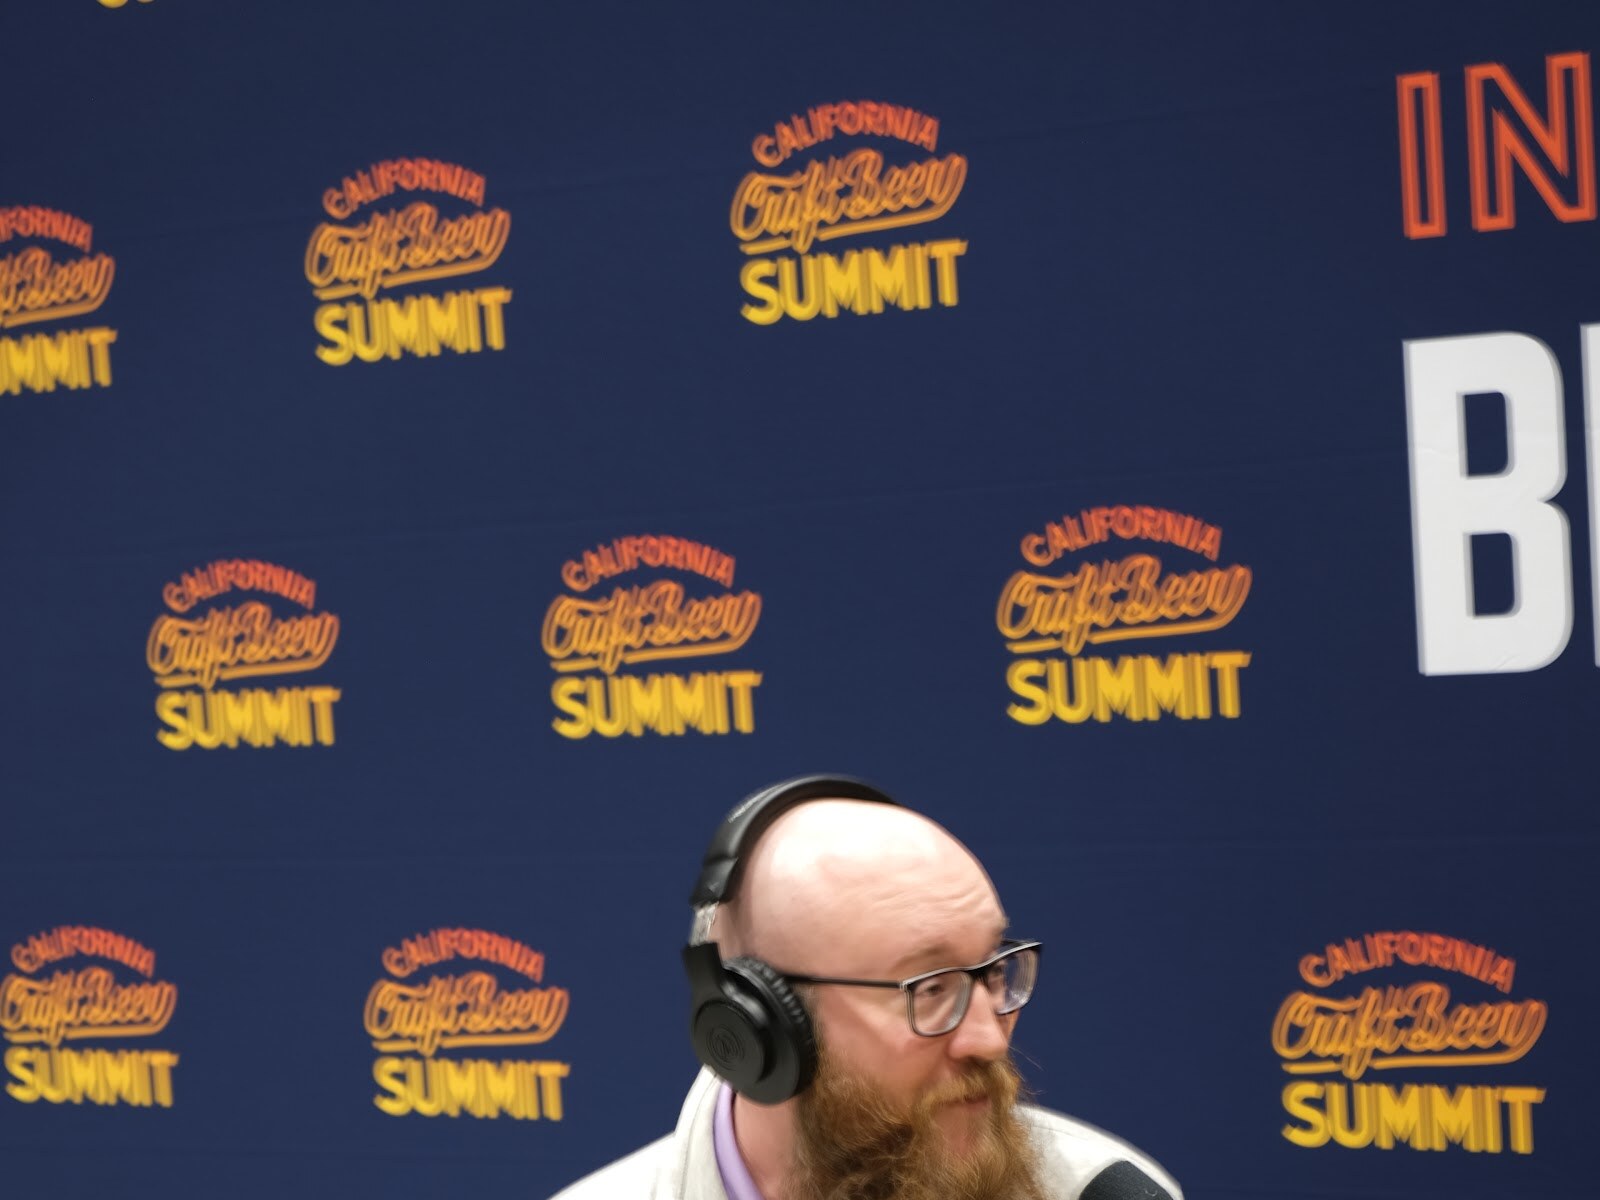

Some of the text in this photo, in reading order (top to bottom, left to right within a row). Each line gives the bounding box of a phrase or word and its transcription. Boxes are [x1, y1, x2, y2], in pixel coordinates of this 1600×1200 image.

[752, 101, 940, 167] CALIFORNIA
[323, 158, 487, 219] CALIFORNIA
[730, 148, 968, 255] Craft Beer
[304, 202, 512, 300] Craft Beer
[740, 238, 969, 326] SUMMIT
[314, 287, 513, 366] SUMMIT
[0, 327, 117, 395] MMIT
[562, 535, 736, 592] CALIFORNIA
[1020, 505, 1223, 567] CALIFORNIA
[163, 559, 316, 613] CALIFORNIA
[996, 553, 1253, 656] Craft Beer
[146, 600, 341, 690] Craft Beer
[541, 579, 762, 675] Craft Beer
[155, 686, 342, 751] SUMMIT
[551, 670, 763, 739] SUMMIT
[1006, 651, 1253, 726] SUMMIT
[11, 925, 156, 978] CALIFORNIA
[382, 927, 545, 983] CALIFORNIA
[1299, 931, 1517, 993] CALIFORNIA
[363, 970, 570, 1057] Craft Beer
[1271, 981, 1549, 1080] Craft Beer
[4, 1046, 181, 1108] SUMMIT
[373, 1056, 571, 1121] SUMMIT
[1281, 1081, 1548, 1154] SUMMIT
